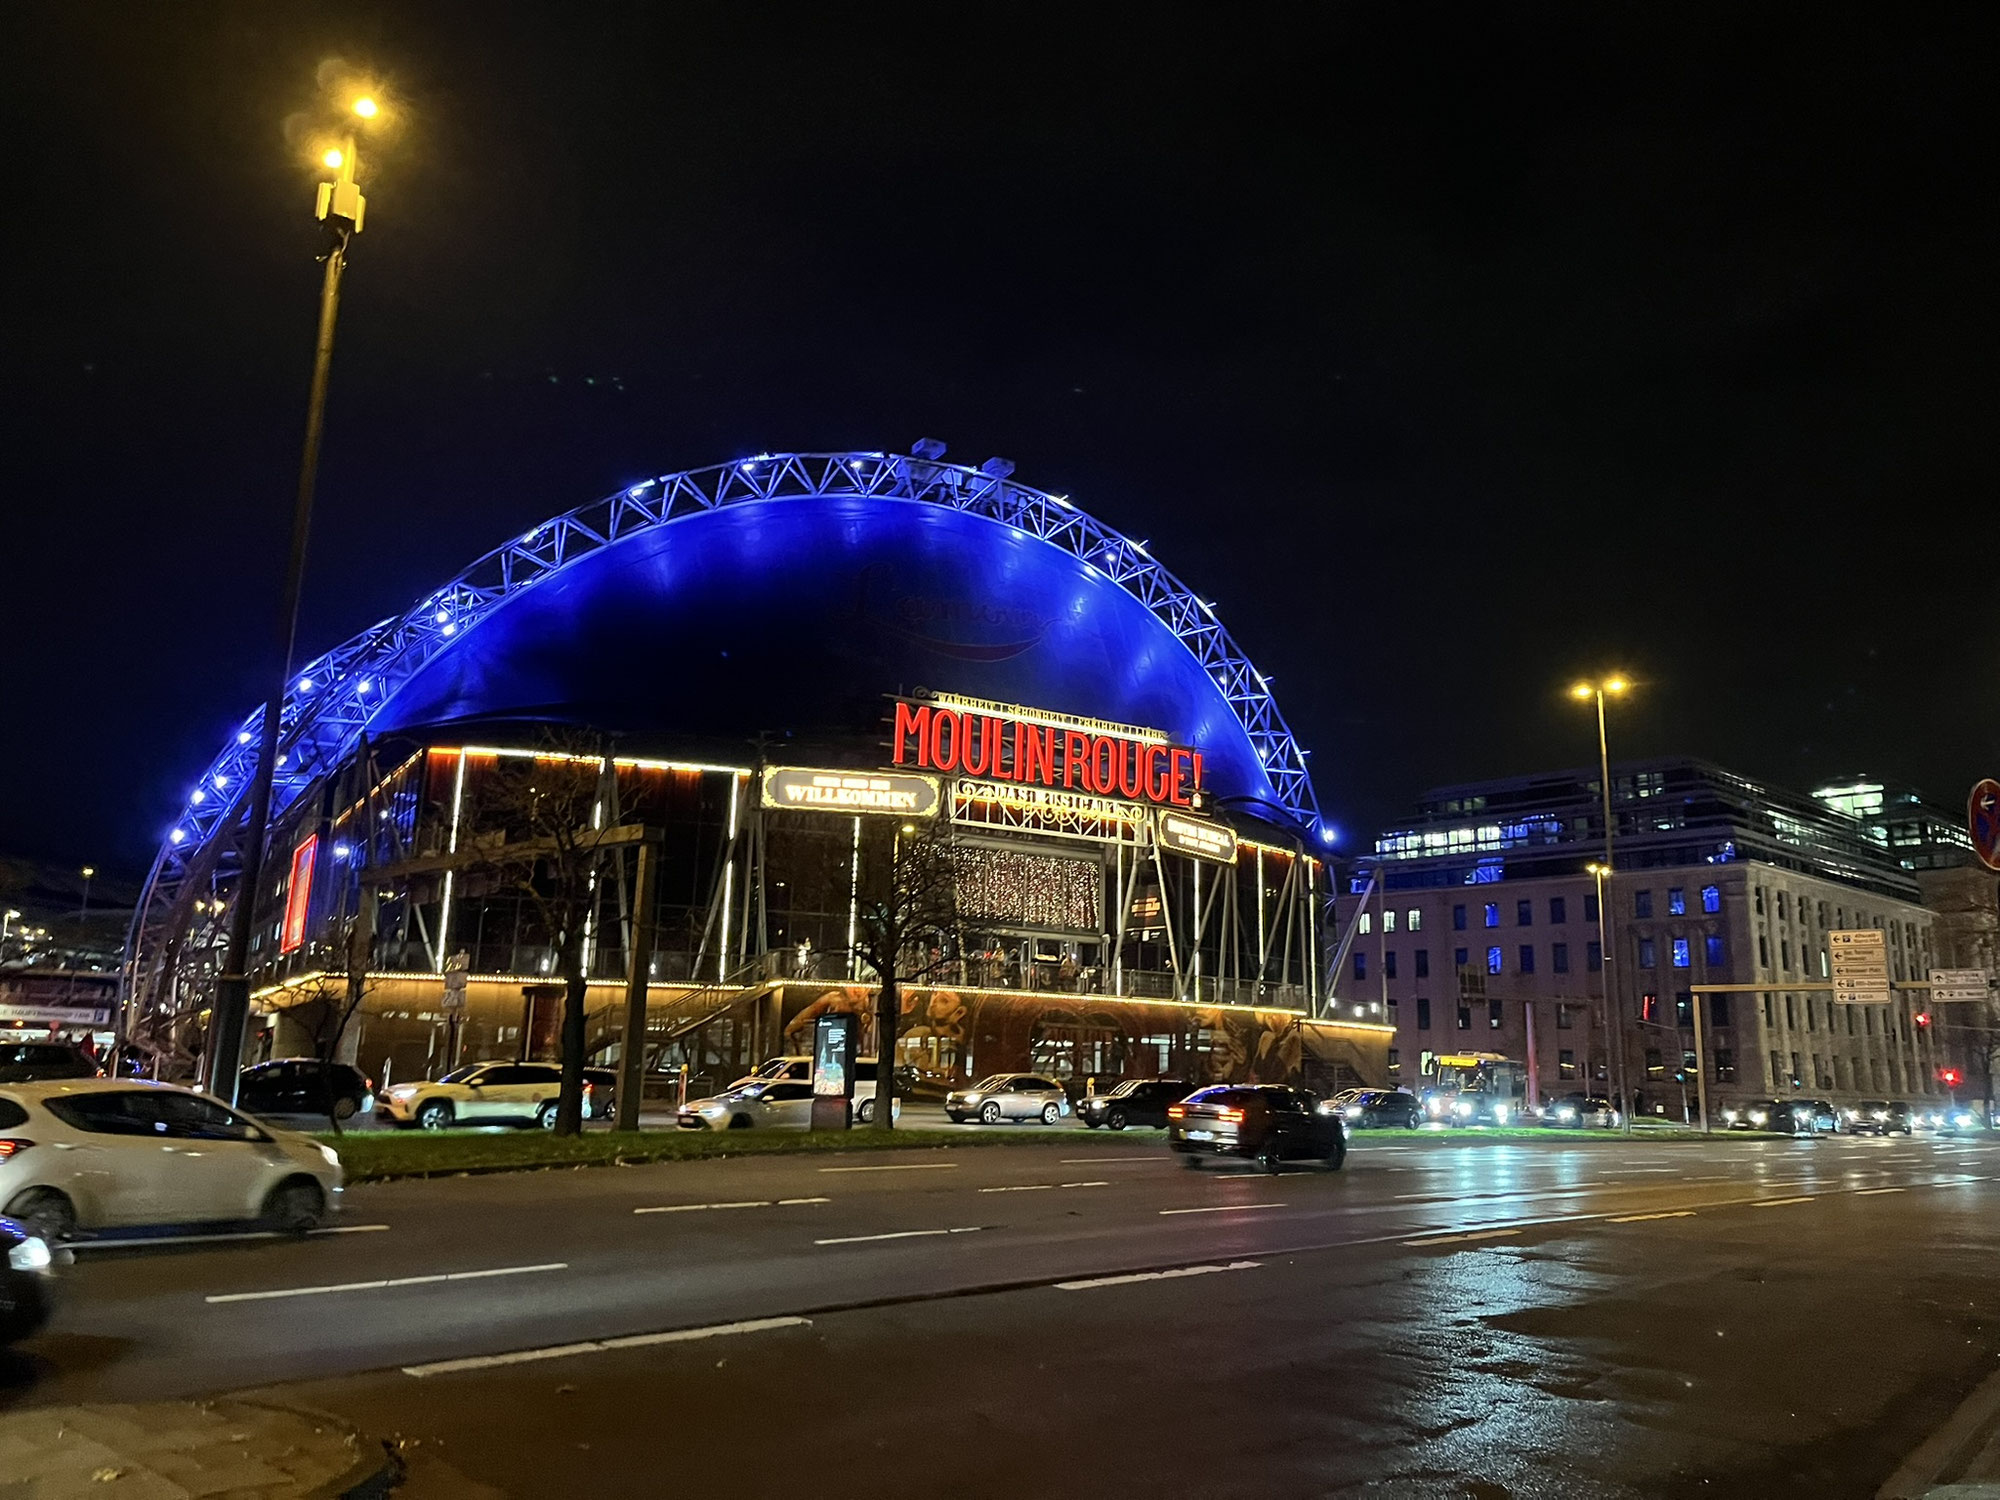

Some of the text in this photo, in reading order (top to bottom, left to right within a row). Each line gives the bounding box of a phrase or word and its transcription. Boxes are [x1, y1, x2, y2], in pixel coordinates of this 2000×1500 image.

[938, 692, 995, 711] WAHRHEIT
[1079, 717, 1124, 734] FREIHEIT
[892, 701, 1202, 808] MOULIN ROUGE!
[785, 784, 918, 808] WILLKOMMEN
